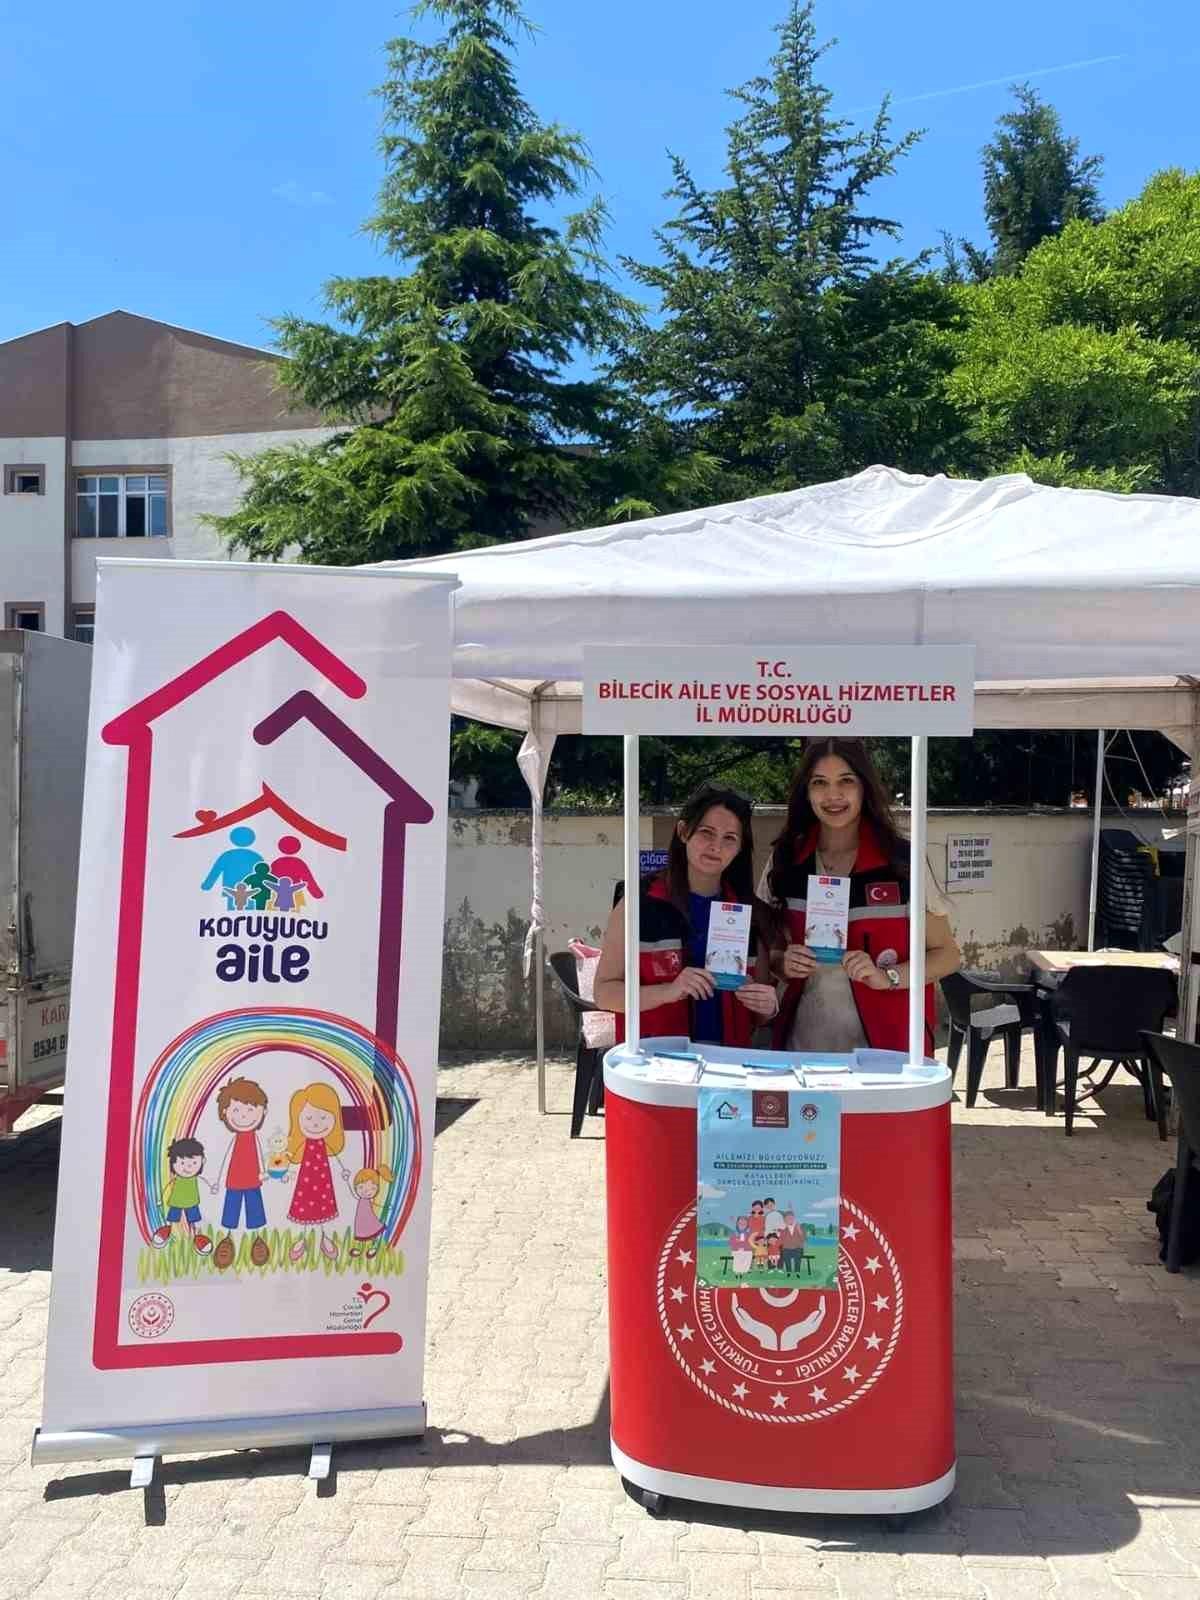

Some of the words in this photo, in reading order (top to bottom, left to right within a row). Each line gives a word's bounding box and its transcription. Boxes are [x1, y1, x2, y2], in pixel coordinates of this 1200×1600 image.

[757, 661, 792, 678] T.C.
[599, 680, 673, 699] BİLECİK
[678, 681, 721, 700] AİLE
[726, 684, 750, 700] VE
[756, 684, 833, 701] SOSYAL
[839, 682, 957, 702] HİZMETLER
[696, 704, 713, 723] İL
[718, 704, 852, 724] MÜDÜRLÜĞÜ
[640, 852, 669, 866] ÇİĞDE
[216, 944, 310, 983] aile
